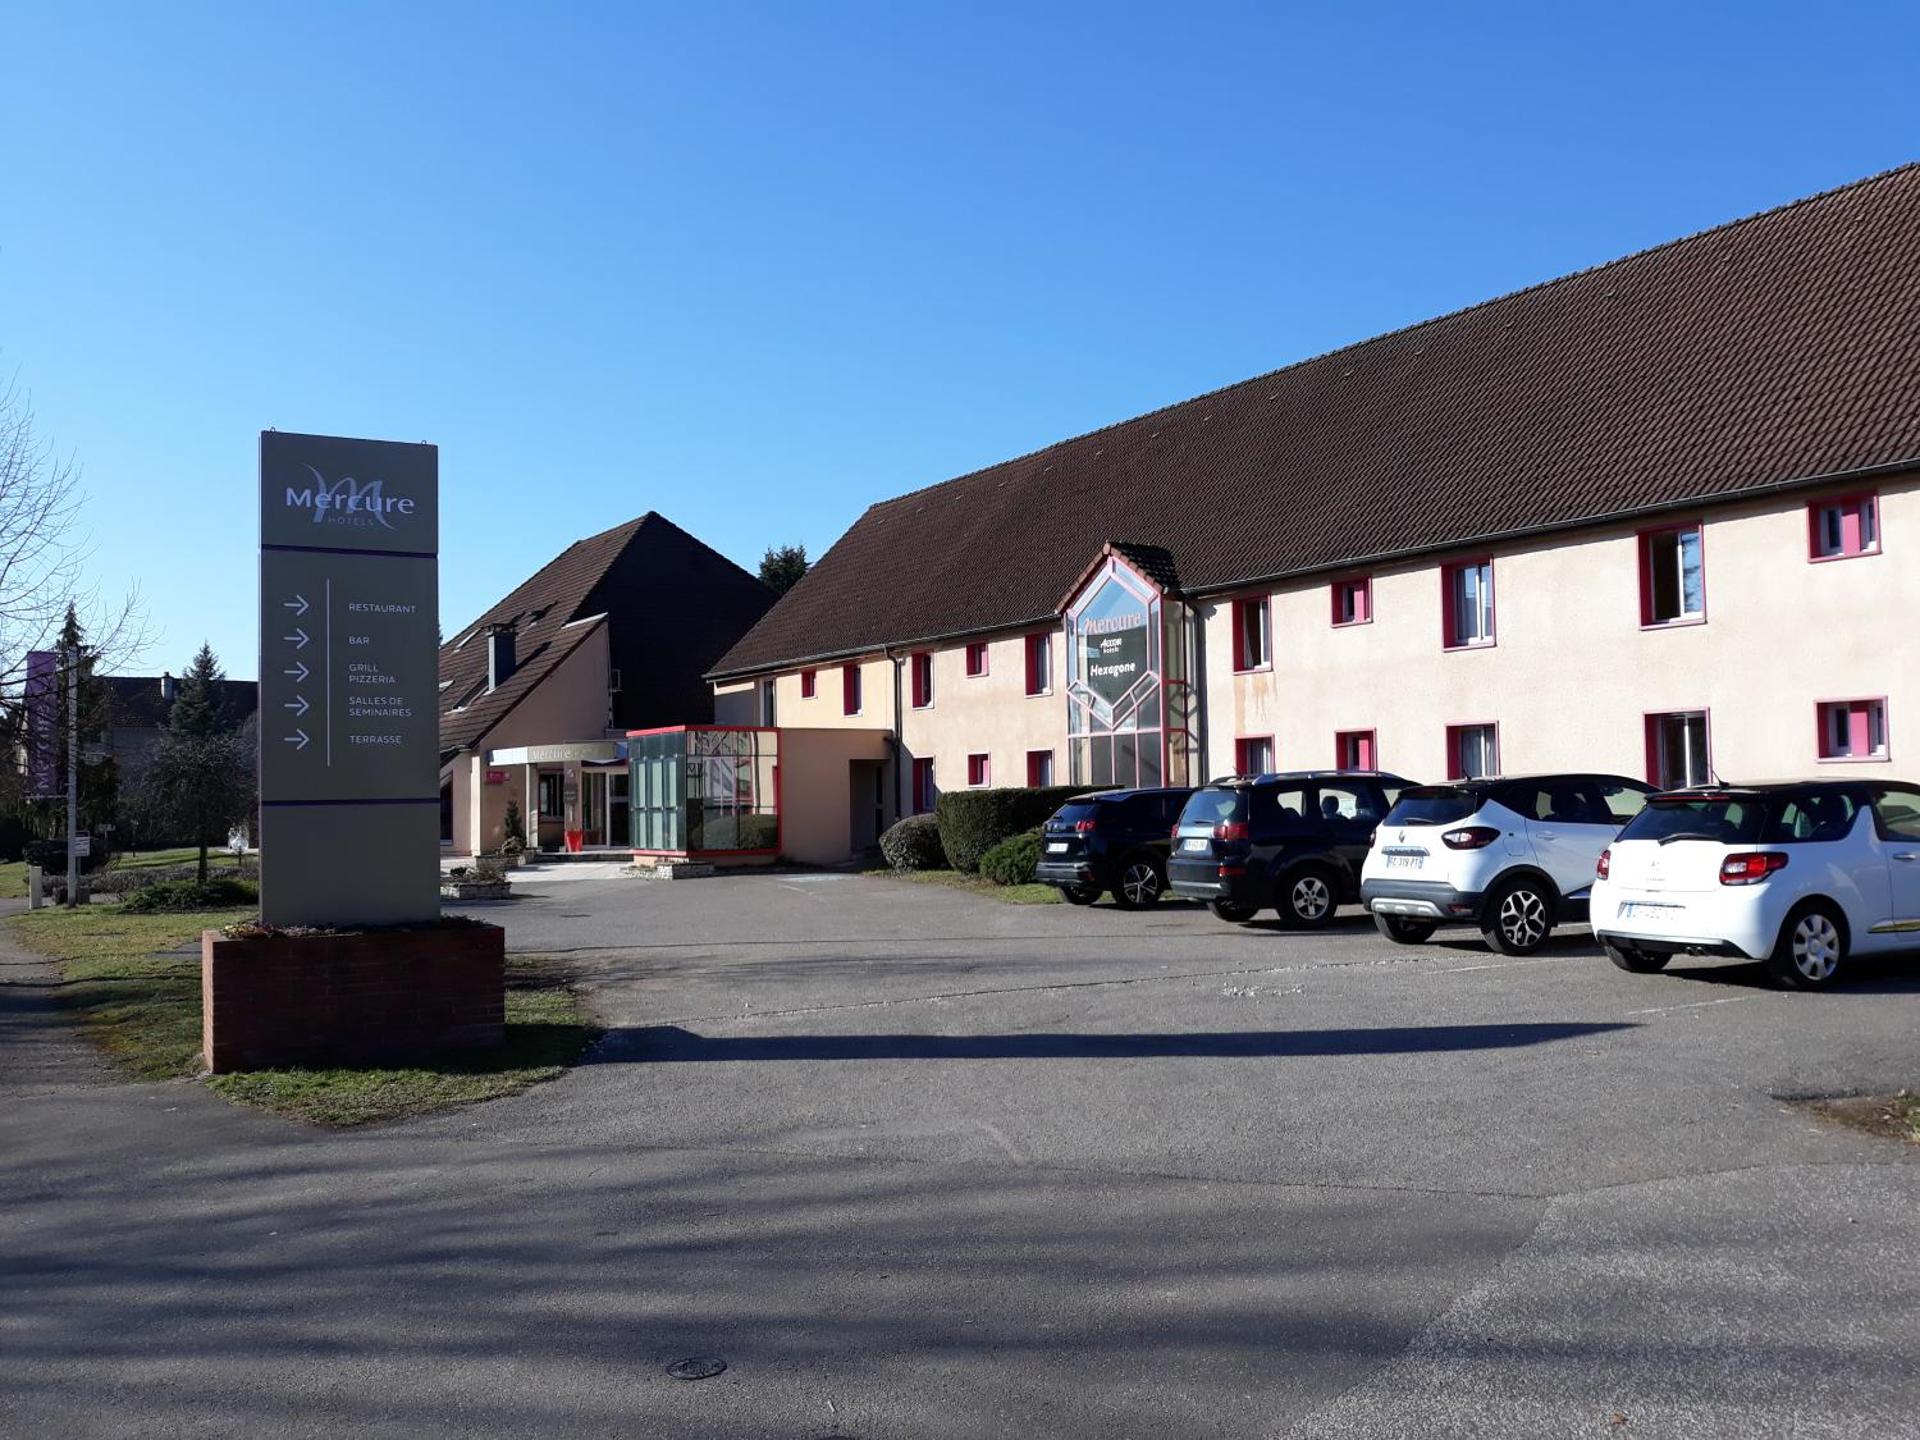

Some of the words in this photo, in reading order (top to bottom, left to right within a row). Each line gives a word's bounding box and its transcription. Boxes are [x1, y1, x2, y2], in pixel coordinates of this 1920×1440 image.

[286, 487, 415, 514] Mercure
[328, 517, 375, 526] HOTELS
[348, 603, 416, 613] RESTAURANT
[348, 636, 370, 645] BAR
[348, 664, 379, 673] GRILL
[1090, 662, 1136, 677] Hexagone
[348, 675, 396, 684] PIZZERIA
[349, 697, 386, 705] SALLES
[388, 697, 403, 705] DE
[349, 736, 402, 744] TERRASSE
